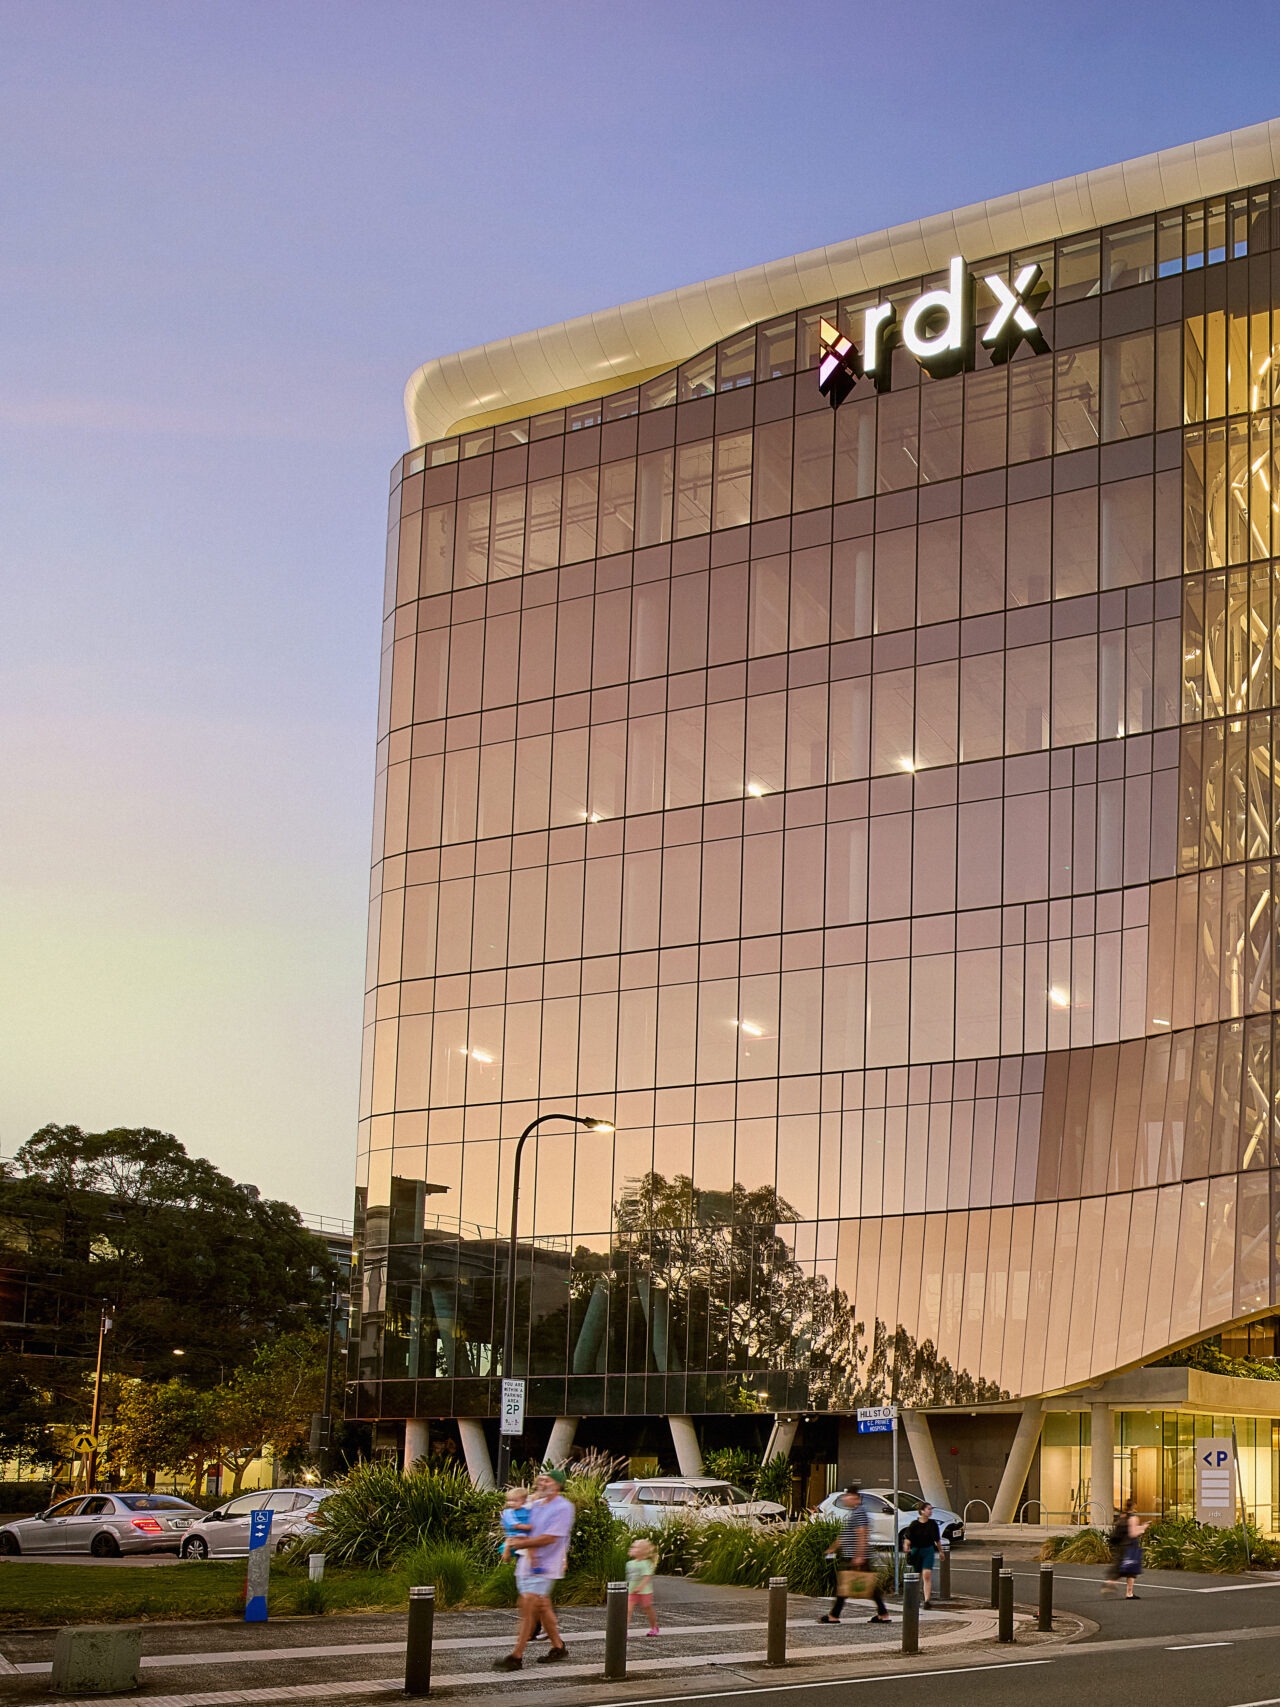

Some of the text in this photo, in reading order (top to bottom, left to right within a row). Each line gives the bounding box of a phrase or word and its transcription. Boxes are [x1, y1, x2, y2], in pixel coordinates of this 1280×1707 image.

[862, 255, 1039, 373] rdx
[506, 1404, 520, 1415] 2P
[860, 1409, 881, 1418] HILL ST
